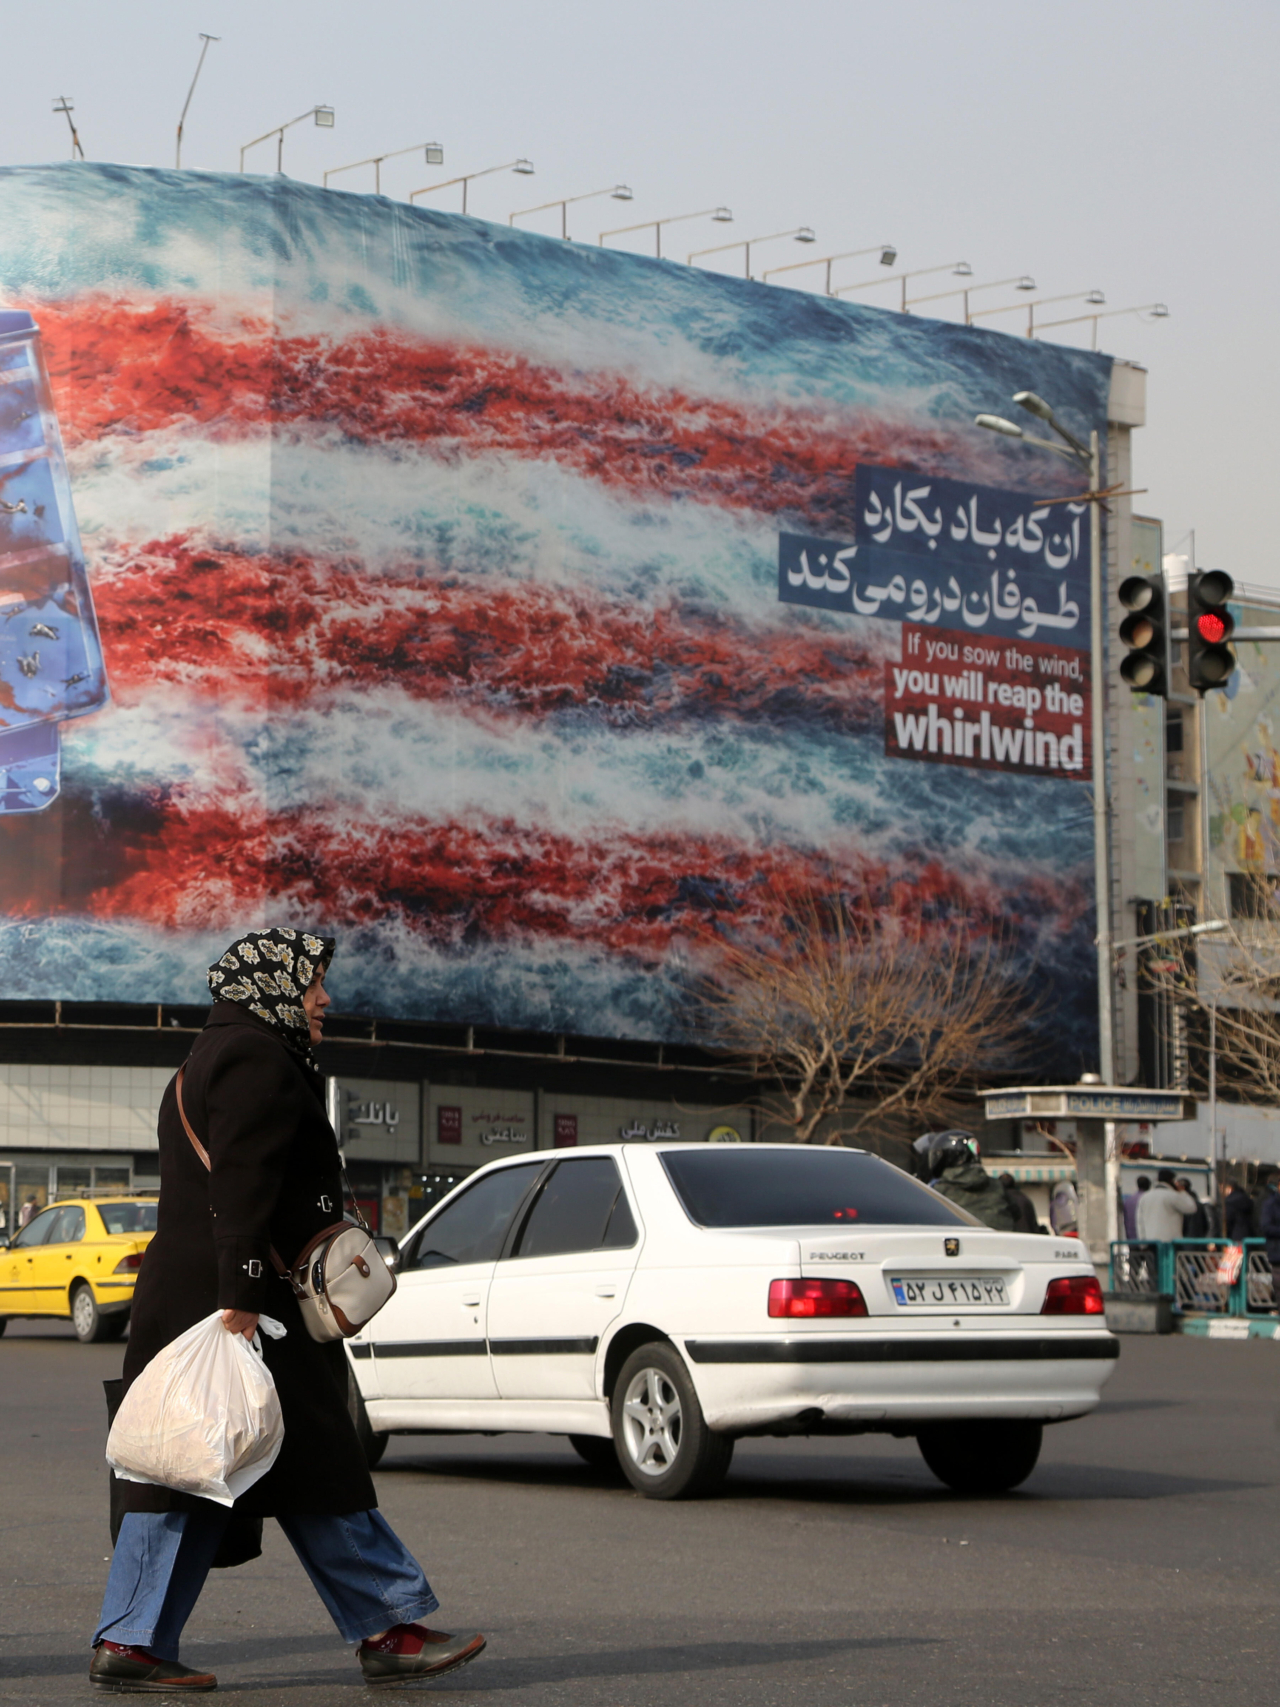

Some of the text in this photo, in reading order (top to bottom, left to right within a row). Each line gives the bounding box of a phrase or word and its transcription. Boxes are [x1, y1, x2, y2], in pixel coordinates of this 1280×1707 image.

[863, 480, 943, 550] بکارد
[950, 494, 1003, 560] باد
[962, 567, 1080, 638] طوفان
[907, 632, 1084, 682] If you sow the wind,
[892, 666, 1083, 716] you will reap the
[893, 703, 1084, 770] whirlwind
[1070, 1096, 1120, 1114] POLICE
[809, 1251, 866, 1261] PEUGEOT
[906, 1282, 926, 1302] ۵۲
[947, 1282, 982, 1302] ۴۱۵
[984, 1286, 1004, 1302] ۲۲
